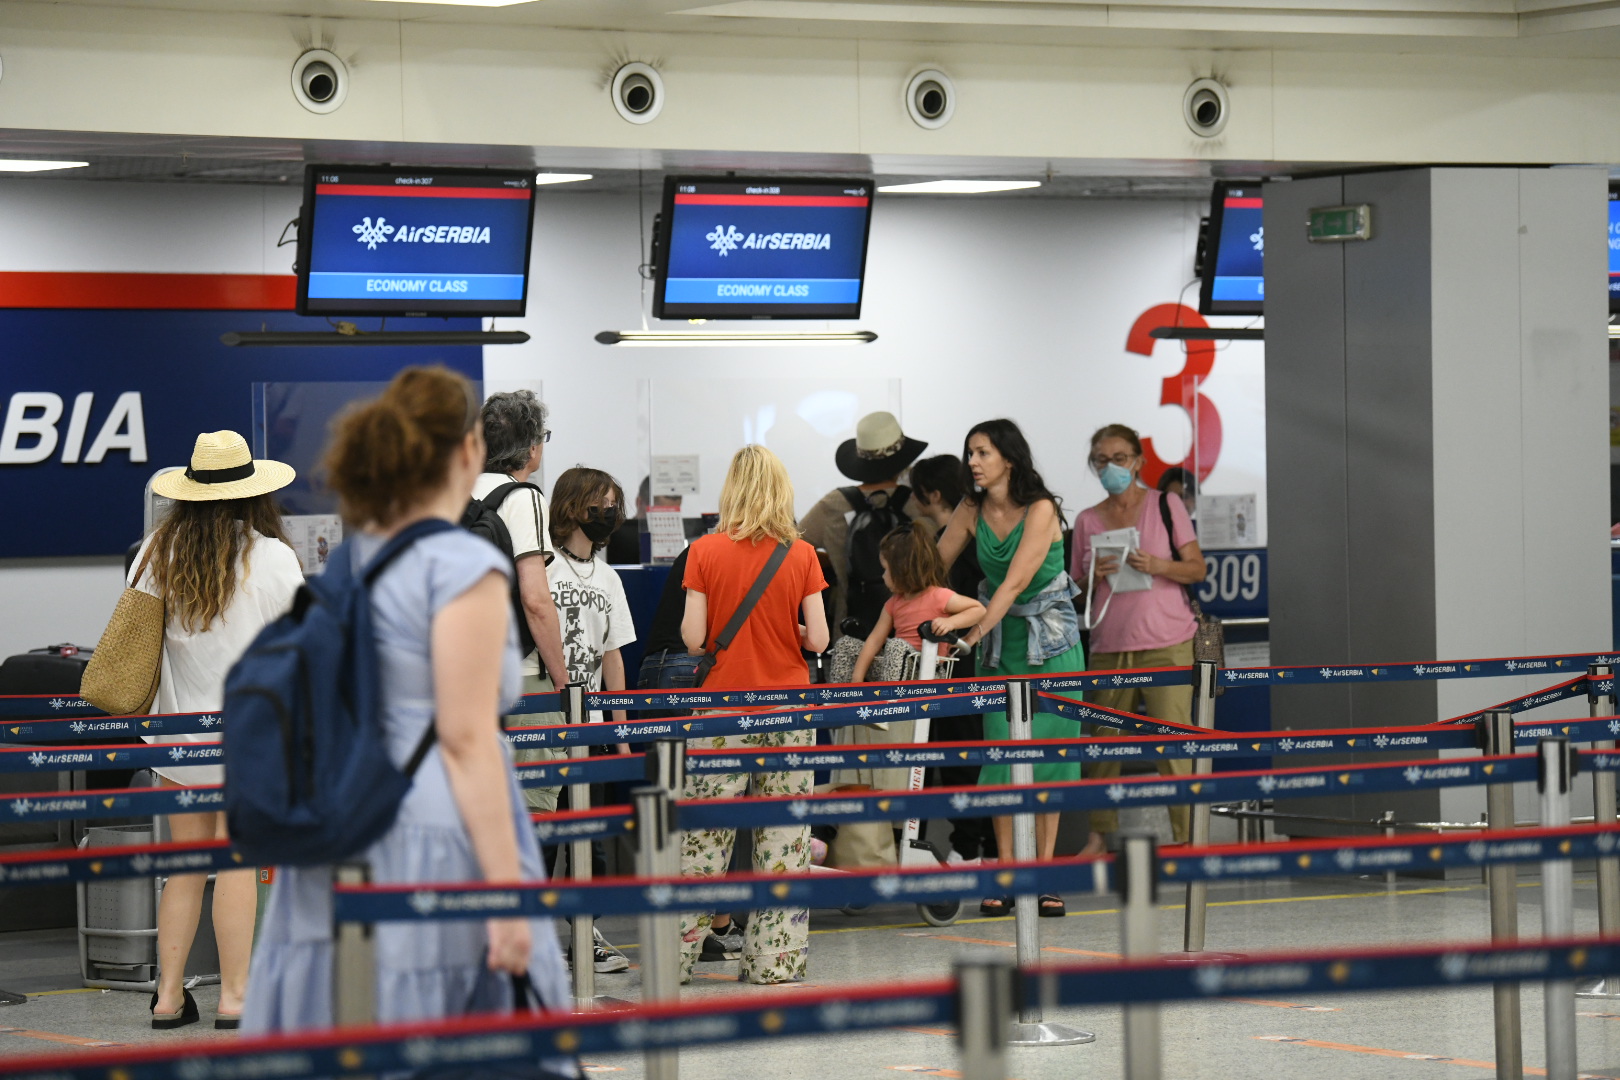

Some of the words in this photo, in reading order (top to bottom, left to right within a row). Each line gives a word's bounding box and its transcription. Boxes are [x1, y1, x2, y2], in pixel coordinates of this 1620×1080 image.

[393, 225, 491, 244] AirSERBIA
[742, 232, 831, 250] AirSERBIA
[366, 279, 427, 293] ECONOMY
[429, 280, 468, 293] CLASS
[717, 284, 772, 297] ECONOMY
[773, 285, 809, 297] CLASS
[1125, 302, 1223, 490] 3
[555, 580, 573, 590] THE
[1199, 554, 1261, 602] 309
[1517, 661, 1548, 669] AirSERBIA
[1238, 671, 1270, 680] AirSERBIA
[1332, 669, 1364, 677] AirSERBIA
[1425, 665, 1456, 674] AirSERBIA
[681, 696, 712, 704] AirSERBIA
[757, 693, 789, 701] AirSERBIA
[833, 690, 864, 698] AirSERBIA
[907, 687, 937, 695] AirSERBIA
[980, 683, 1006, 692] AirSERBI
[1052, 680, 1082, 688] AirSERBIA
[1123, 676, 1153, 684] AirSERBIA
[505, 734, 546, 743] AirSERBIA
[631, 725, 671, 735] AirSERBIA
[753, 716, 793, 726] AirSERBIA
[872, 706, 910, 716] AirSERBIA
[1090, 712, 1124, 725] AirSERBIA
[88, 722, 129, 731] AirSERBIA
[1518, 728, 1553, 738] AirSERBIA
[47, 753, 93, 764] AirSERBIA
[699, 758, 742, 768] AirSERBIA
[803, 755, 845, 765] AirSERBIA
[904, 752, 946, 762] AirSERBIA
[1004, 749, 1045, 759] AirSERBIA
[1102, 746, 1142, 756] AirSERBIA
[1199, 743, 1239, 752] AirSERBIA
[1294, 740, 1334, 749] AirSERBIA
[1389, 736, 1428, 746] AirSERBIA
[1127, 785, 1177, 798] AirSERBIA
[1278, 776, 1326, 789] AirSERBIA
[1423, 766, 1470, 779] AirSERBIA
[33, 800, 87, 812] AirSERBIA
